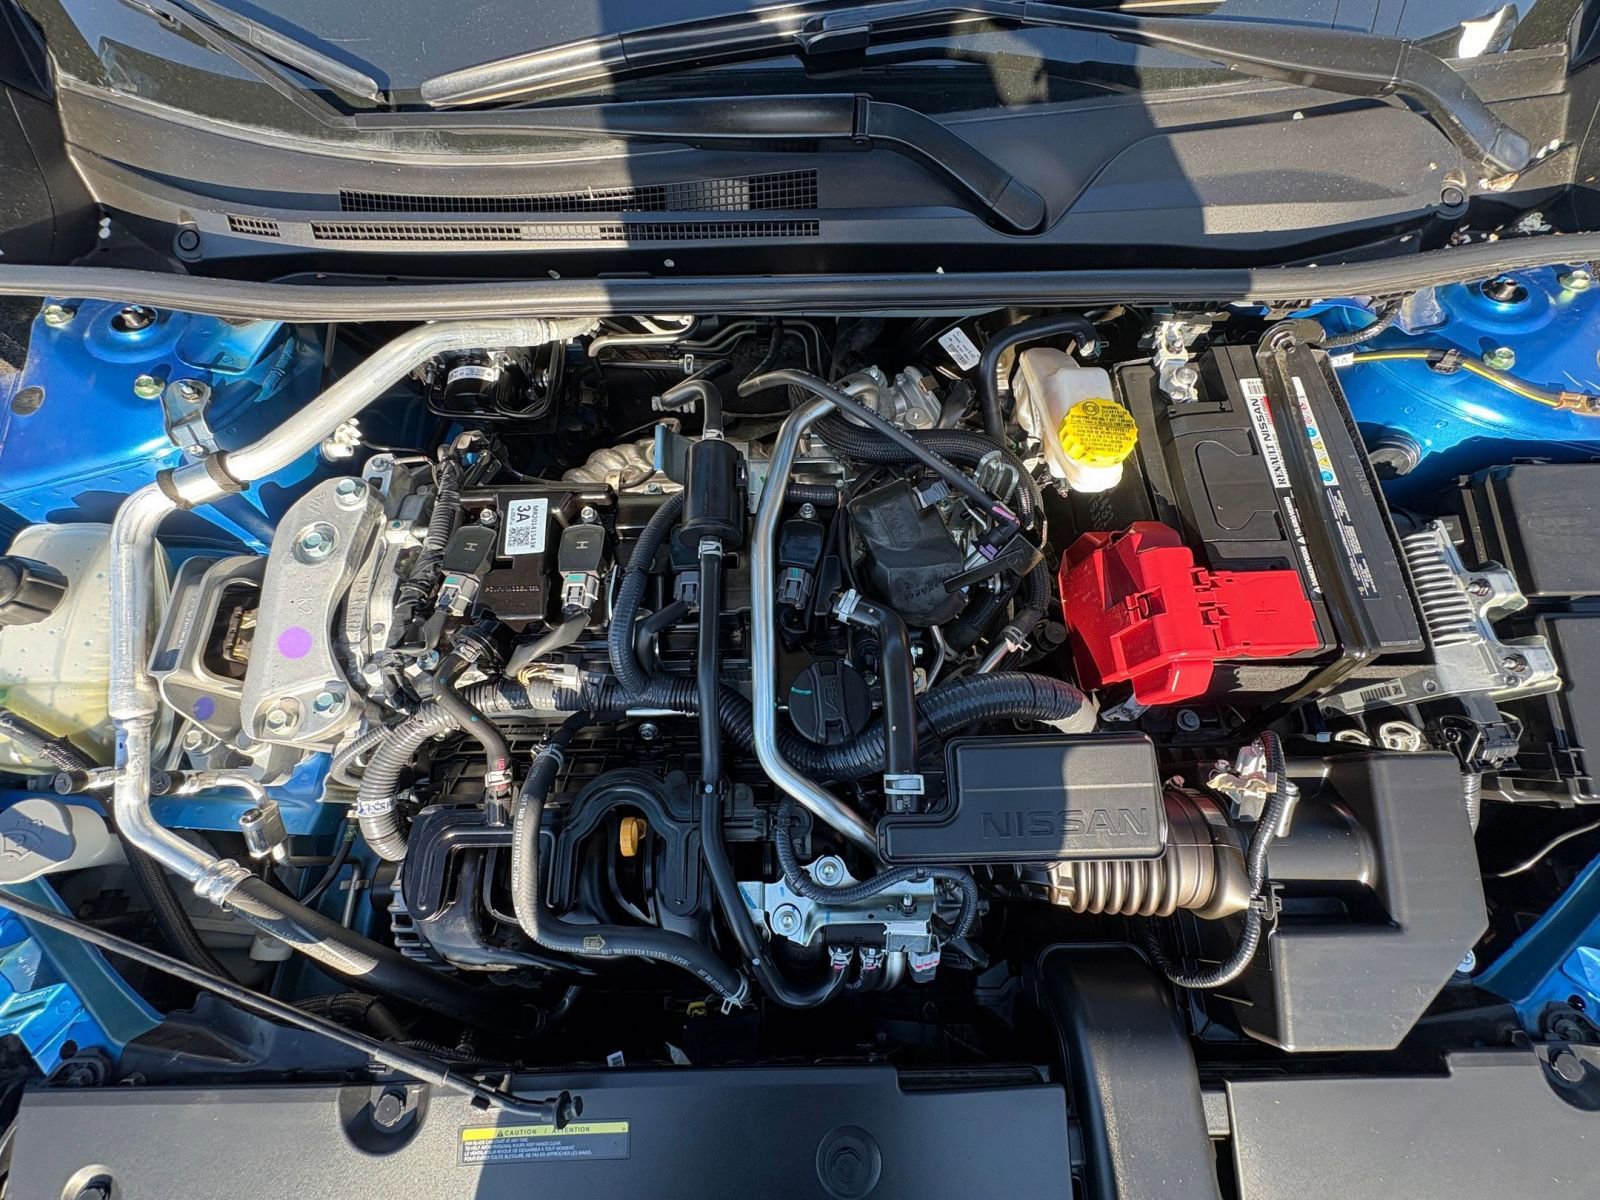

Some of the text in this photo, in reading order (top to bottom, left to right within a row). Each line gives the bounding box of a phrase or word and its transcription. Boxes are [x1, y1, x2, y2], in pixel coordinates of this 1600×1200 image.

[1252, 398, 1270, 441] NISSAN
[1268, 443, 1286, 486] RENAULT
[517, 506, 530, 523] 3A
[980, 808, 1150, 840] NISSAN
